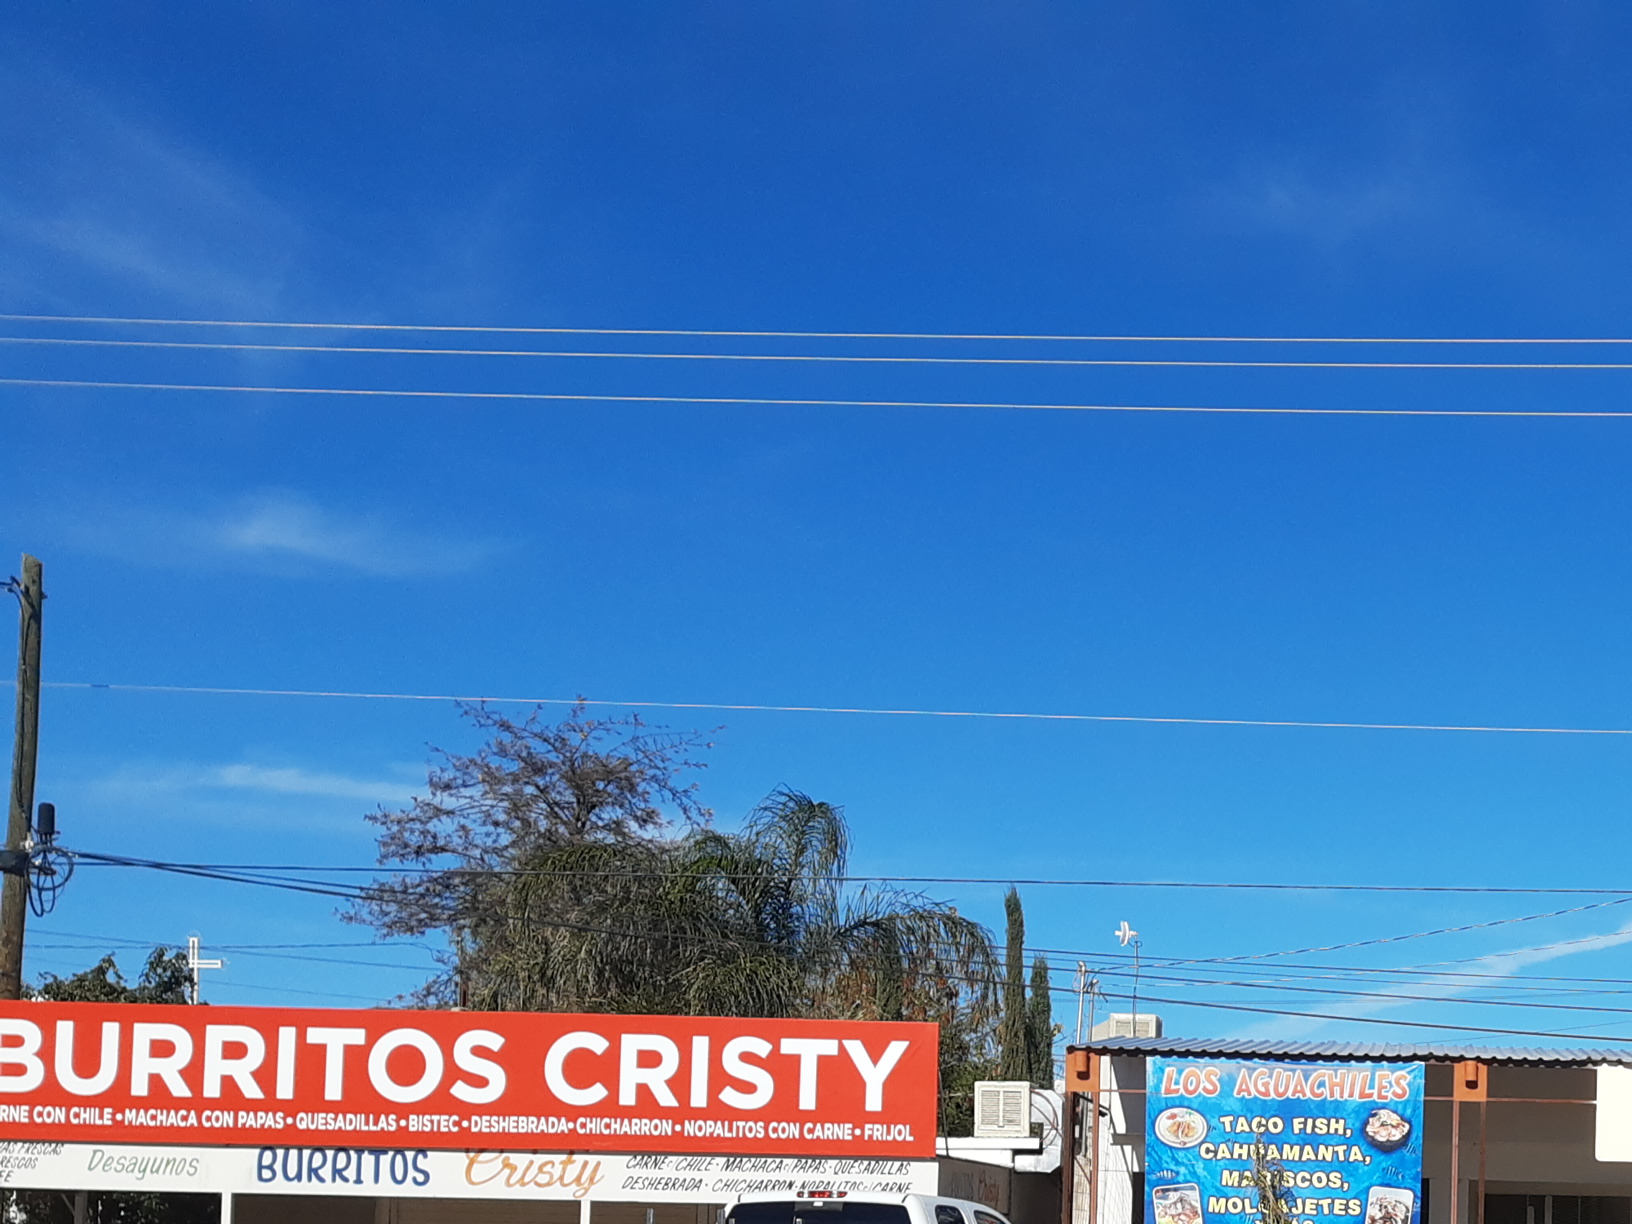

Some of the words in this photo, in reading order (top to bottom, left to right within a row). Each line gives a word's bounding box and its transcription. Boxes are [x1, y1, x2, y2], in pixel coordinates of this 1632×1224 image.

[0, 1018, 507, 1104] BURRITOS
[543, 1030, 911, 1112] CRISTY
[1162, 1066, 1221, 1097] LOS
[1234, 1067, 1410, 1100] AGUACHILES
[33, 1105, 66, 1124] CON
[69, 1106, 113, 1125] CHILE
[124, 1108, 198, 1127] MACHACA
[201, 1109, 234, 1128] CON
[237, 1110, 285, 1129] PAPAS
[296, 1112, 397, 1131] QUESADILLAS
[409, 1114, 460, 1132] BISTEC
[471, 1115, 568, 1134] DESHEBRADA
[576, 1117, 672, 1136] CHICHARRON
[684, 1120, 765, 1138] NOPALITOS
[768, 1122, 799, 1139] CON
[803, 1123, 853, 1140] CARNE
[864, 1124, 914, 1141] FRIJOL
[1220, 1115, 1284, 1134] TACO
[1293, 1117, 1353, 1138] FISH,
[88, 1149, 199, 1181] Desayunos
[833, 1160, 911, 1177] QUESADILLAS
[1200, 1142, 1372, 1166] CAHUAMANTA,
[256, 1147, 430, 1186] BURRITOS
[464, 1149, 604, 1199] Cristy
[622, 1175, 703, 1192] DESHEBRADA
[712, 1178, 795, 1193] CHICHARRON
